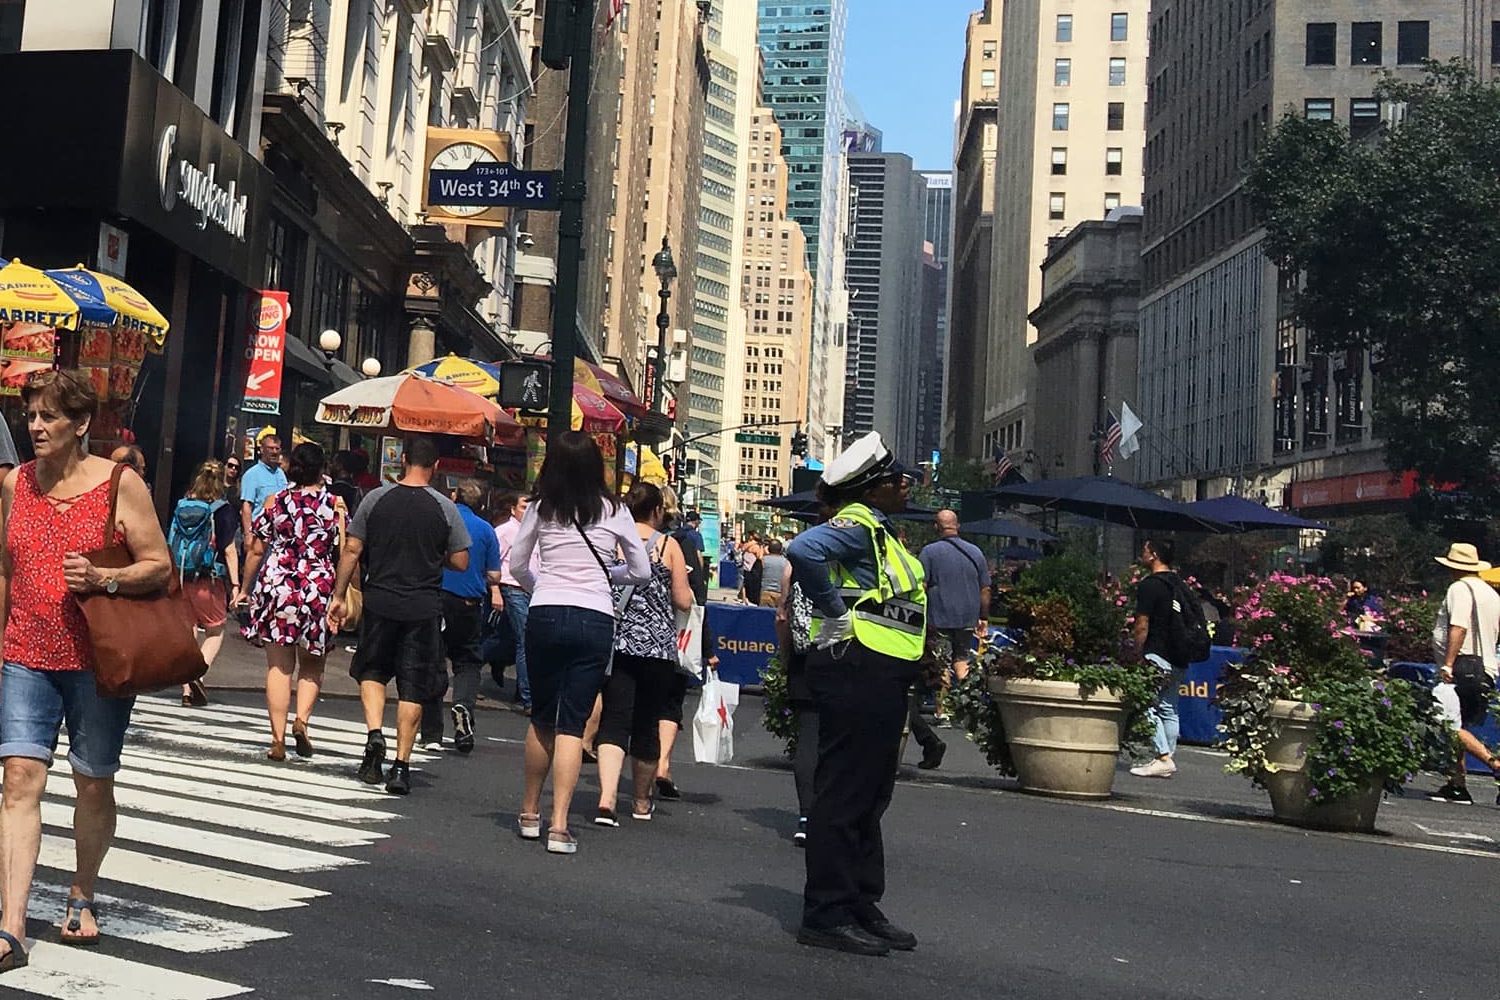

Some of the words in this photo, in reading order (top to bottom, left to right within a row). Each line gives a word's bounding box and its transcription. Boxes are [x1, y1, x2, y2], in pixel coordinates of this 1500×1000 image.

[476, 168, 489, 176] 173
[496, 168, 509, 176] 101
[440, 179, 484, 198] West
[488, 179, 520, 198] 34th
[526, 180, 544, 199] St
[118, 311, 165, 338] BRETT
[245, 348, 281, 362] OPEN
[884, 604, 915, 623] NY
[717, 636, 776, 655] Square
[1178, 681, 1209, 699] ald
